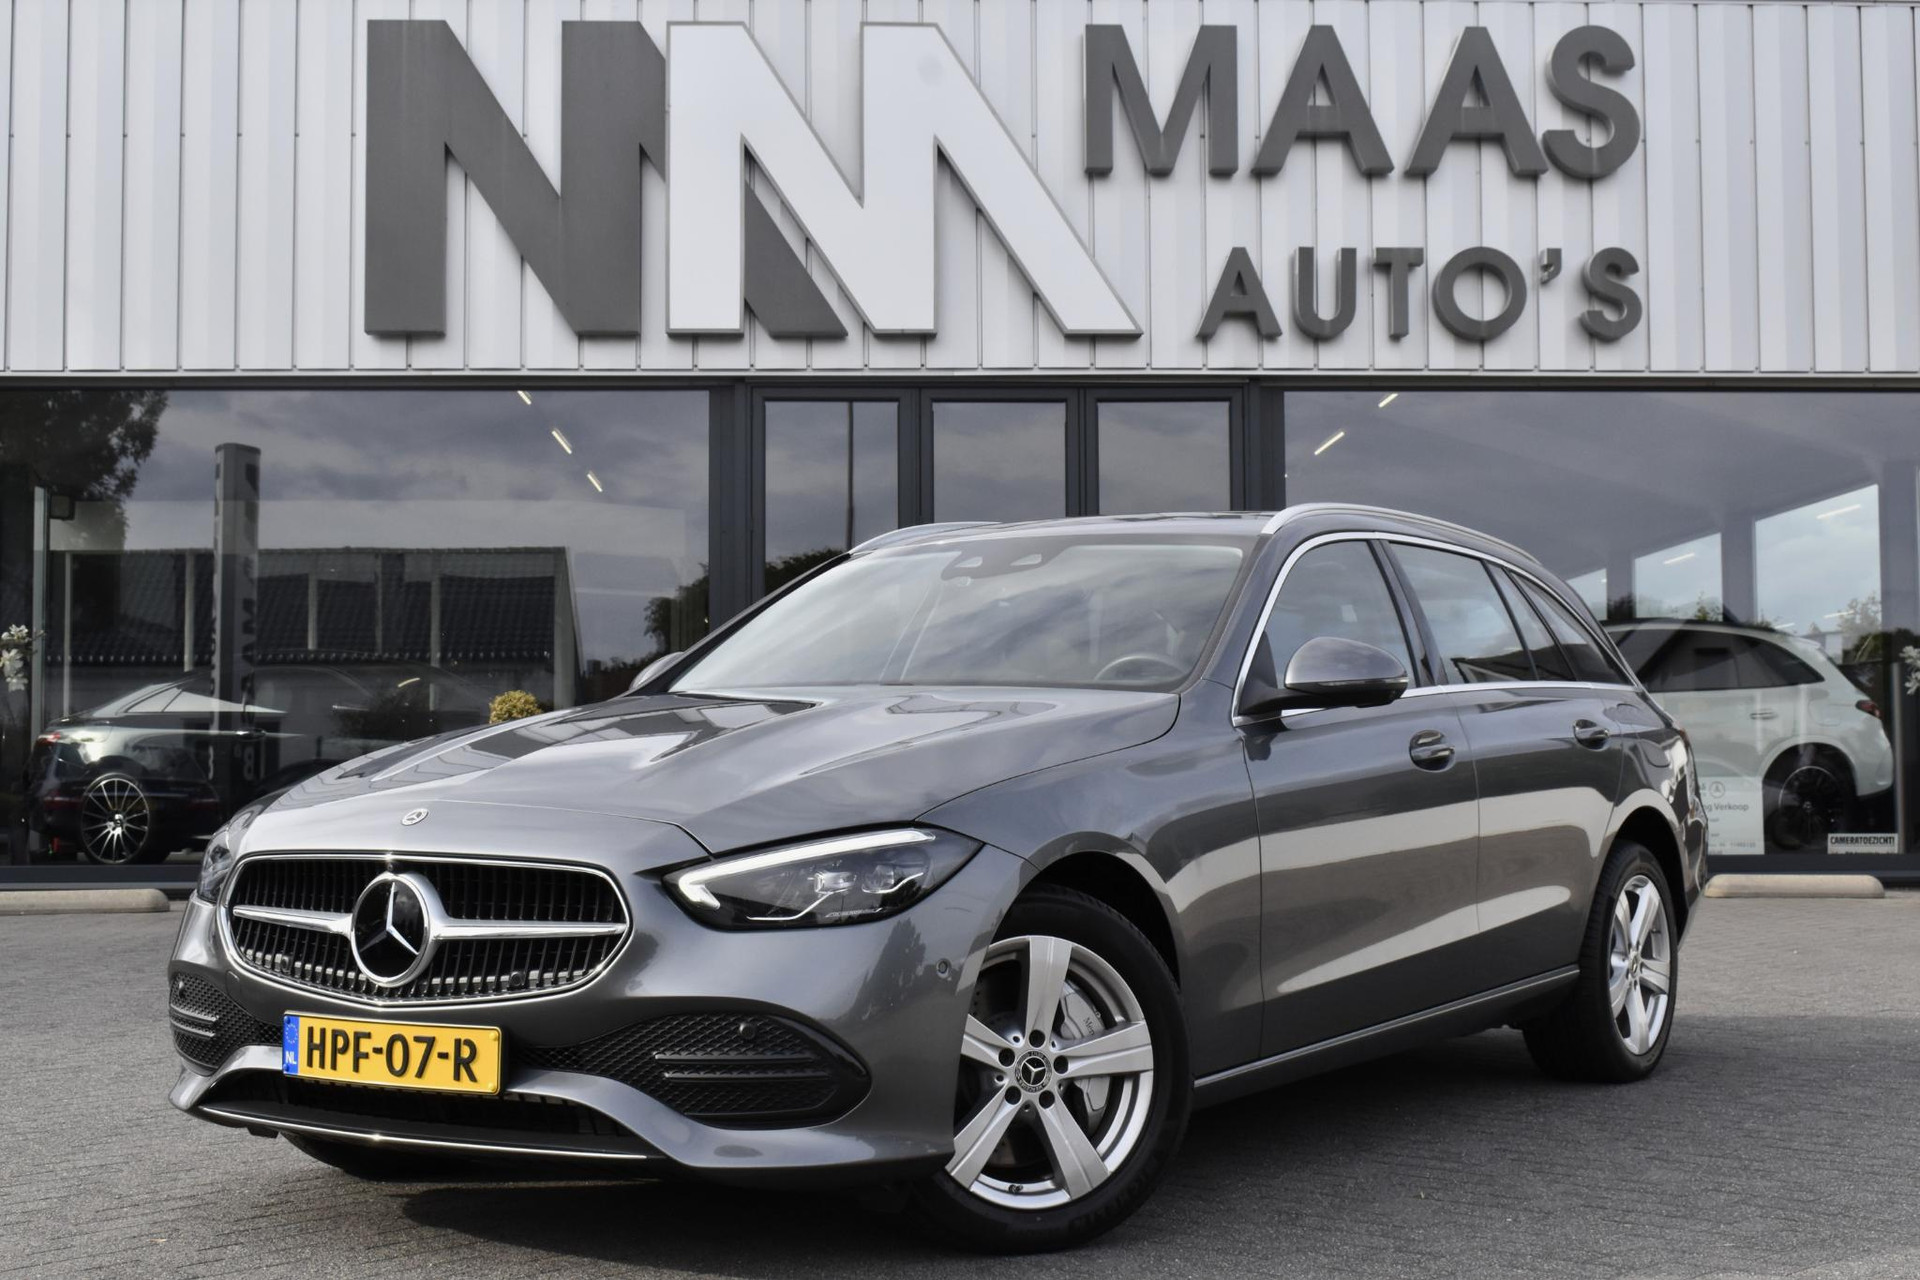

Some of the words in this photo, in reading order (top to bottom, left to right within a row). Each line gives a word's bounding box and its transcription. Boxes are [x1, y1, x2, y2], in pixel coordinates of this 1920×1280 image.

[1083, 24, 1641, 180] MAAS
[1196, 246, 1643, 342] AUTO'S
[1714, 803, 1749, 812] Verkoop
[285, 1050, 297, 1065] NL
[306, 1026, 478, 1083] HPF-07-R
